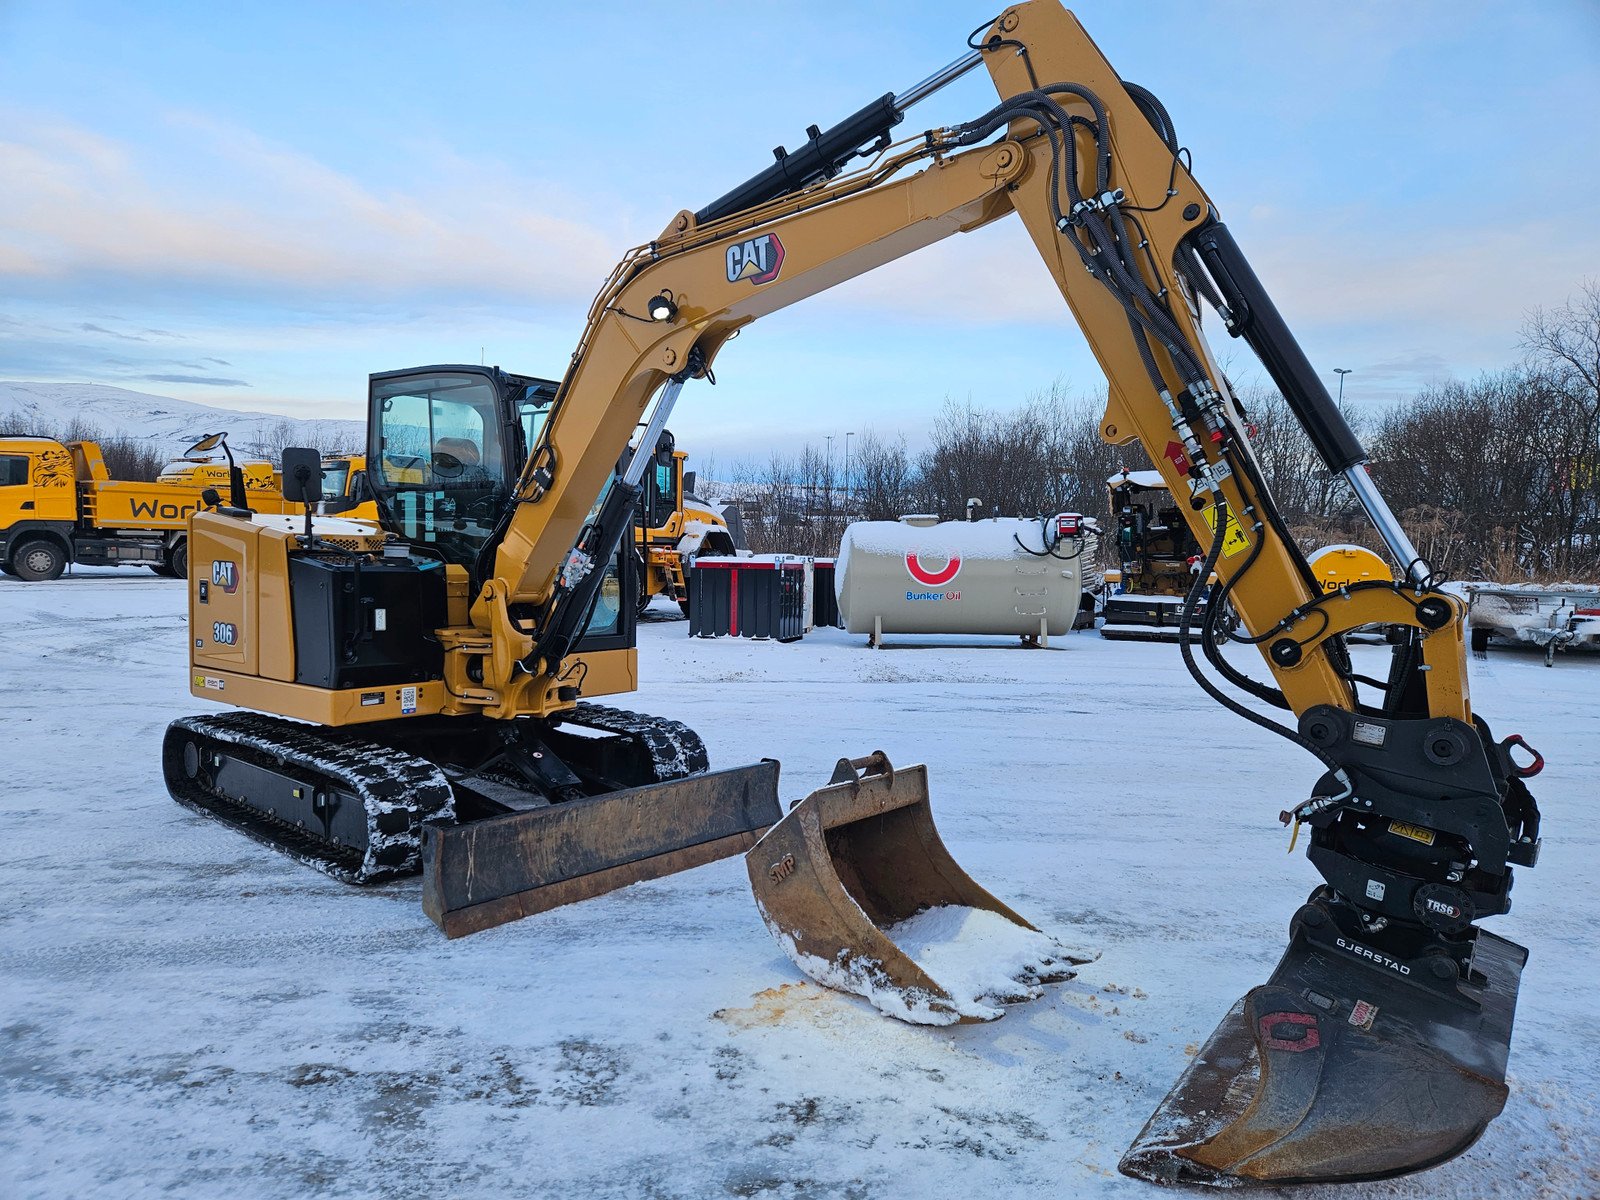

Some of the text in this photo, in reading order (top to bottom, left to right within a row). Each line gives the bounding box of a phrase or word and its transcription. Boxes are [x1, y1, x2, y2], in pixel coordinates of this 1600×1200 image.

[726, 235, 769, 281] CAT
[129, 498, 214, 519] Work
[212, 560, 234, 586] CAT
[906, 591, 962, 601] Bunker Oil
[213, 622, 234, 644] 306
[769, 853, 796, 885] SMP
[1427, 899, 1455, 916] TRS6
[1336, 938, 1411, 975] GJERSTAD
